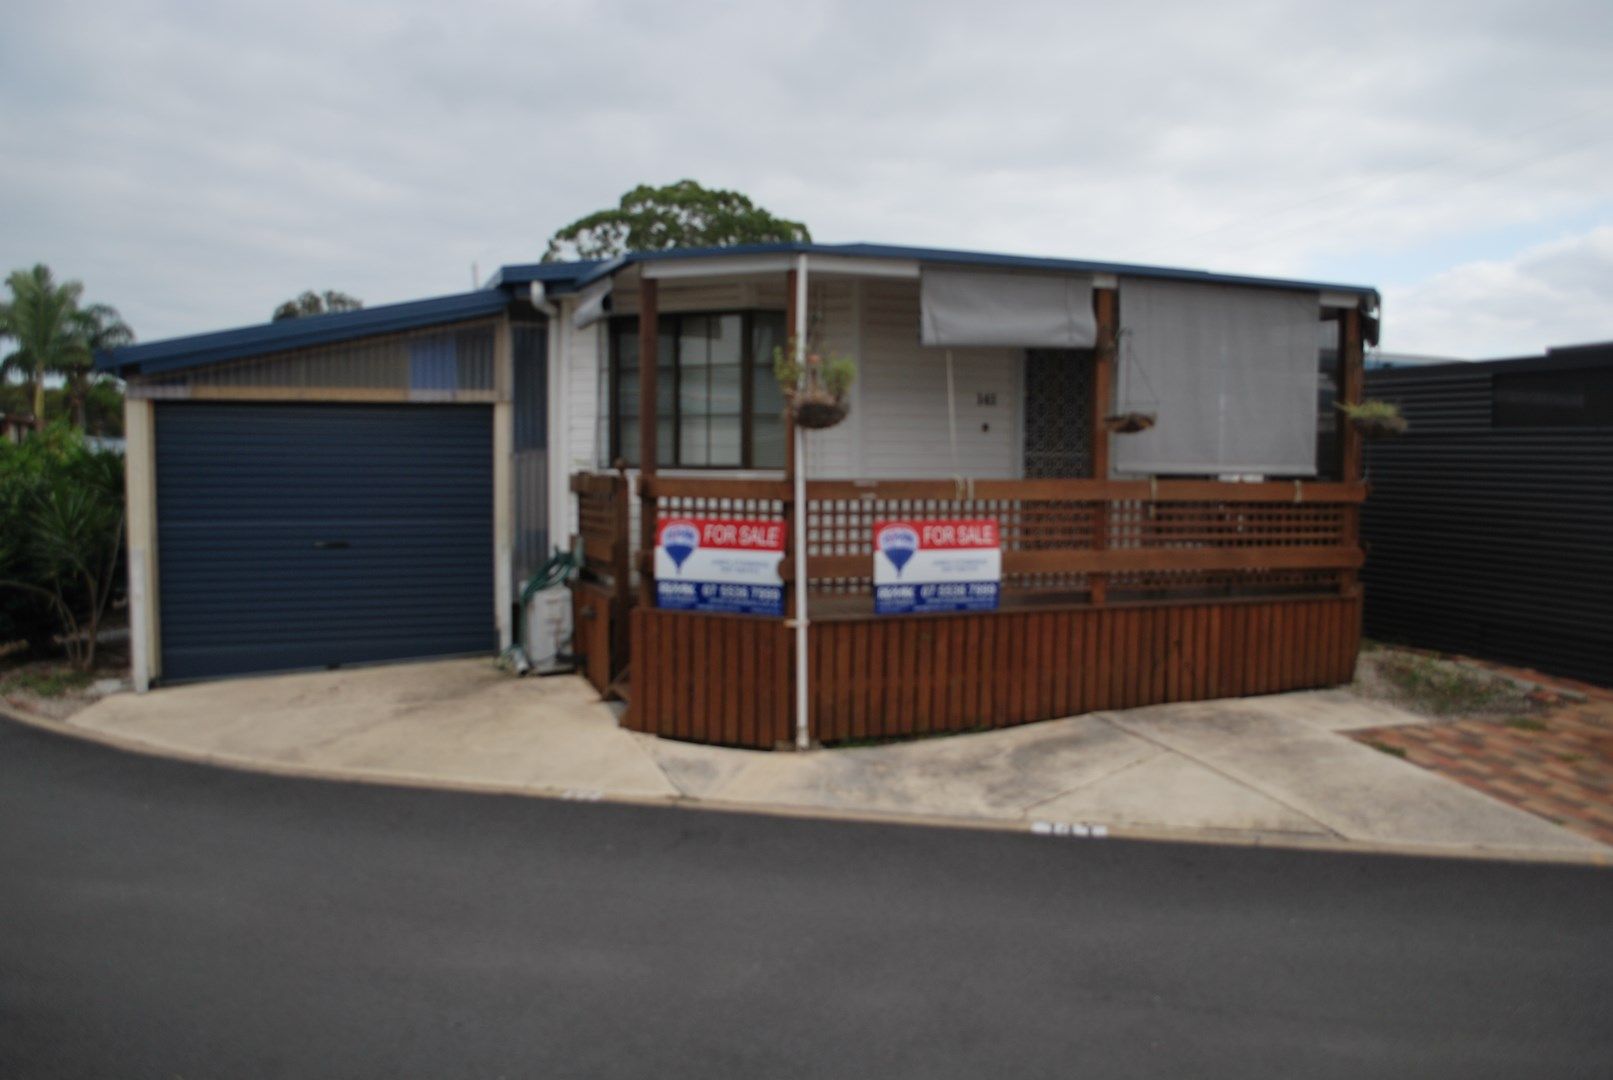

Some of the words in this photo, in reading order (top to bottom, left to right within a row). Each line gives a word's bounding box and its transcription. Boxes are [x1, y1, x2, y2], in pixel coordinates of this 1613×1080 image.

[704, 523, 737, 545] FOR
[738, 525, 780, 547] SALE
[922, 525, 955, 545] FOR
[957, 524, 993, 545] SALE
